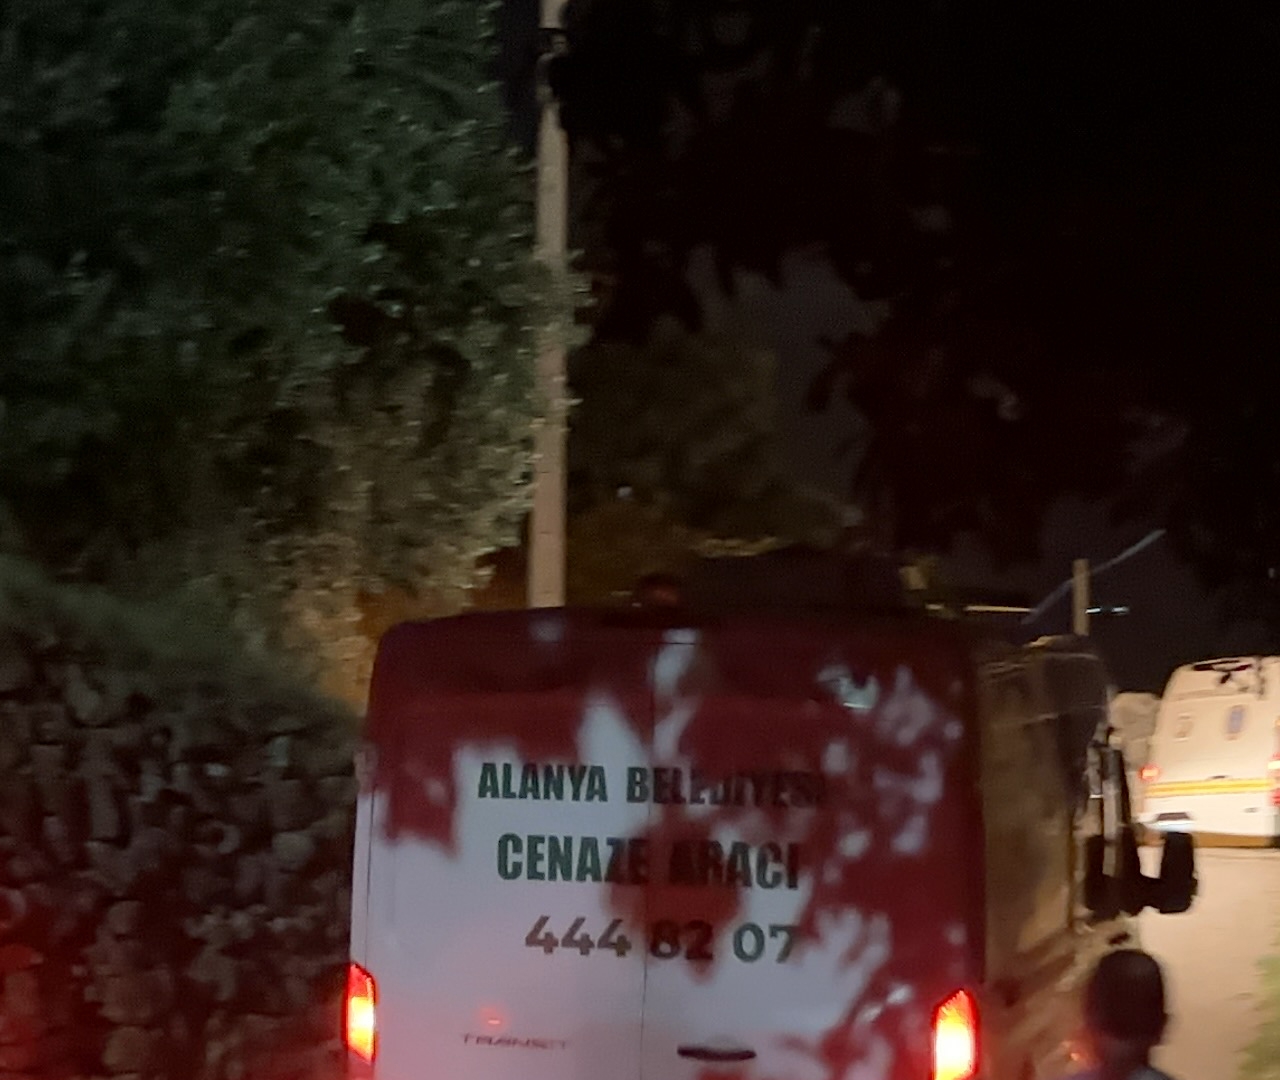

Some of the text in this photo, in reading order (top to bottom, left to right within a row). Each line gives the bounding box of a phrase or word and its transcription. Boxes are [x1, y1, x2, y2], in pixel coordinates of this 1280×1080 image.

[478, 762, 608, 802] ALANYA
[497, 833, 800, 890] CENAZE ARACI
[525, 914, 799, 963] 444 82 07
